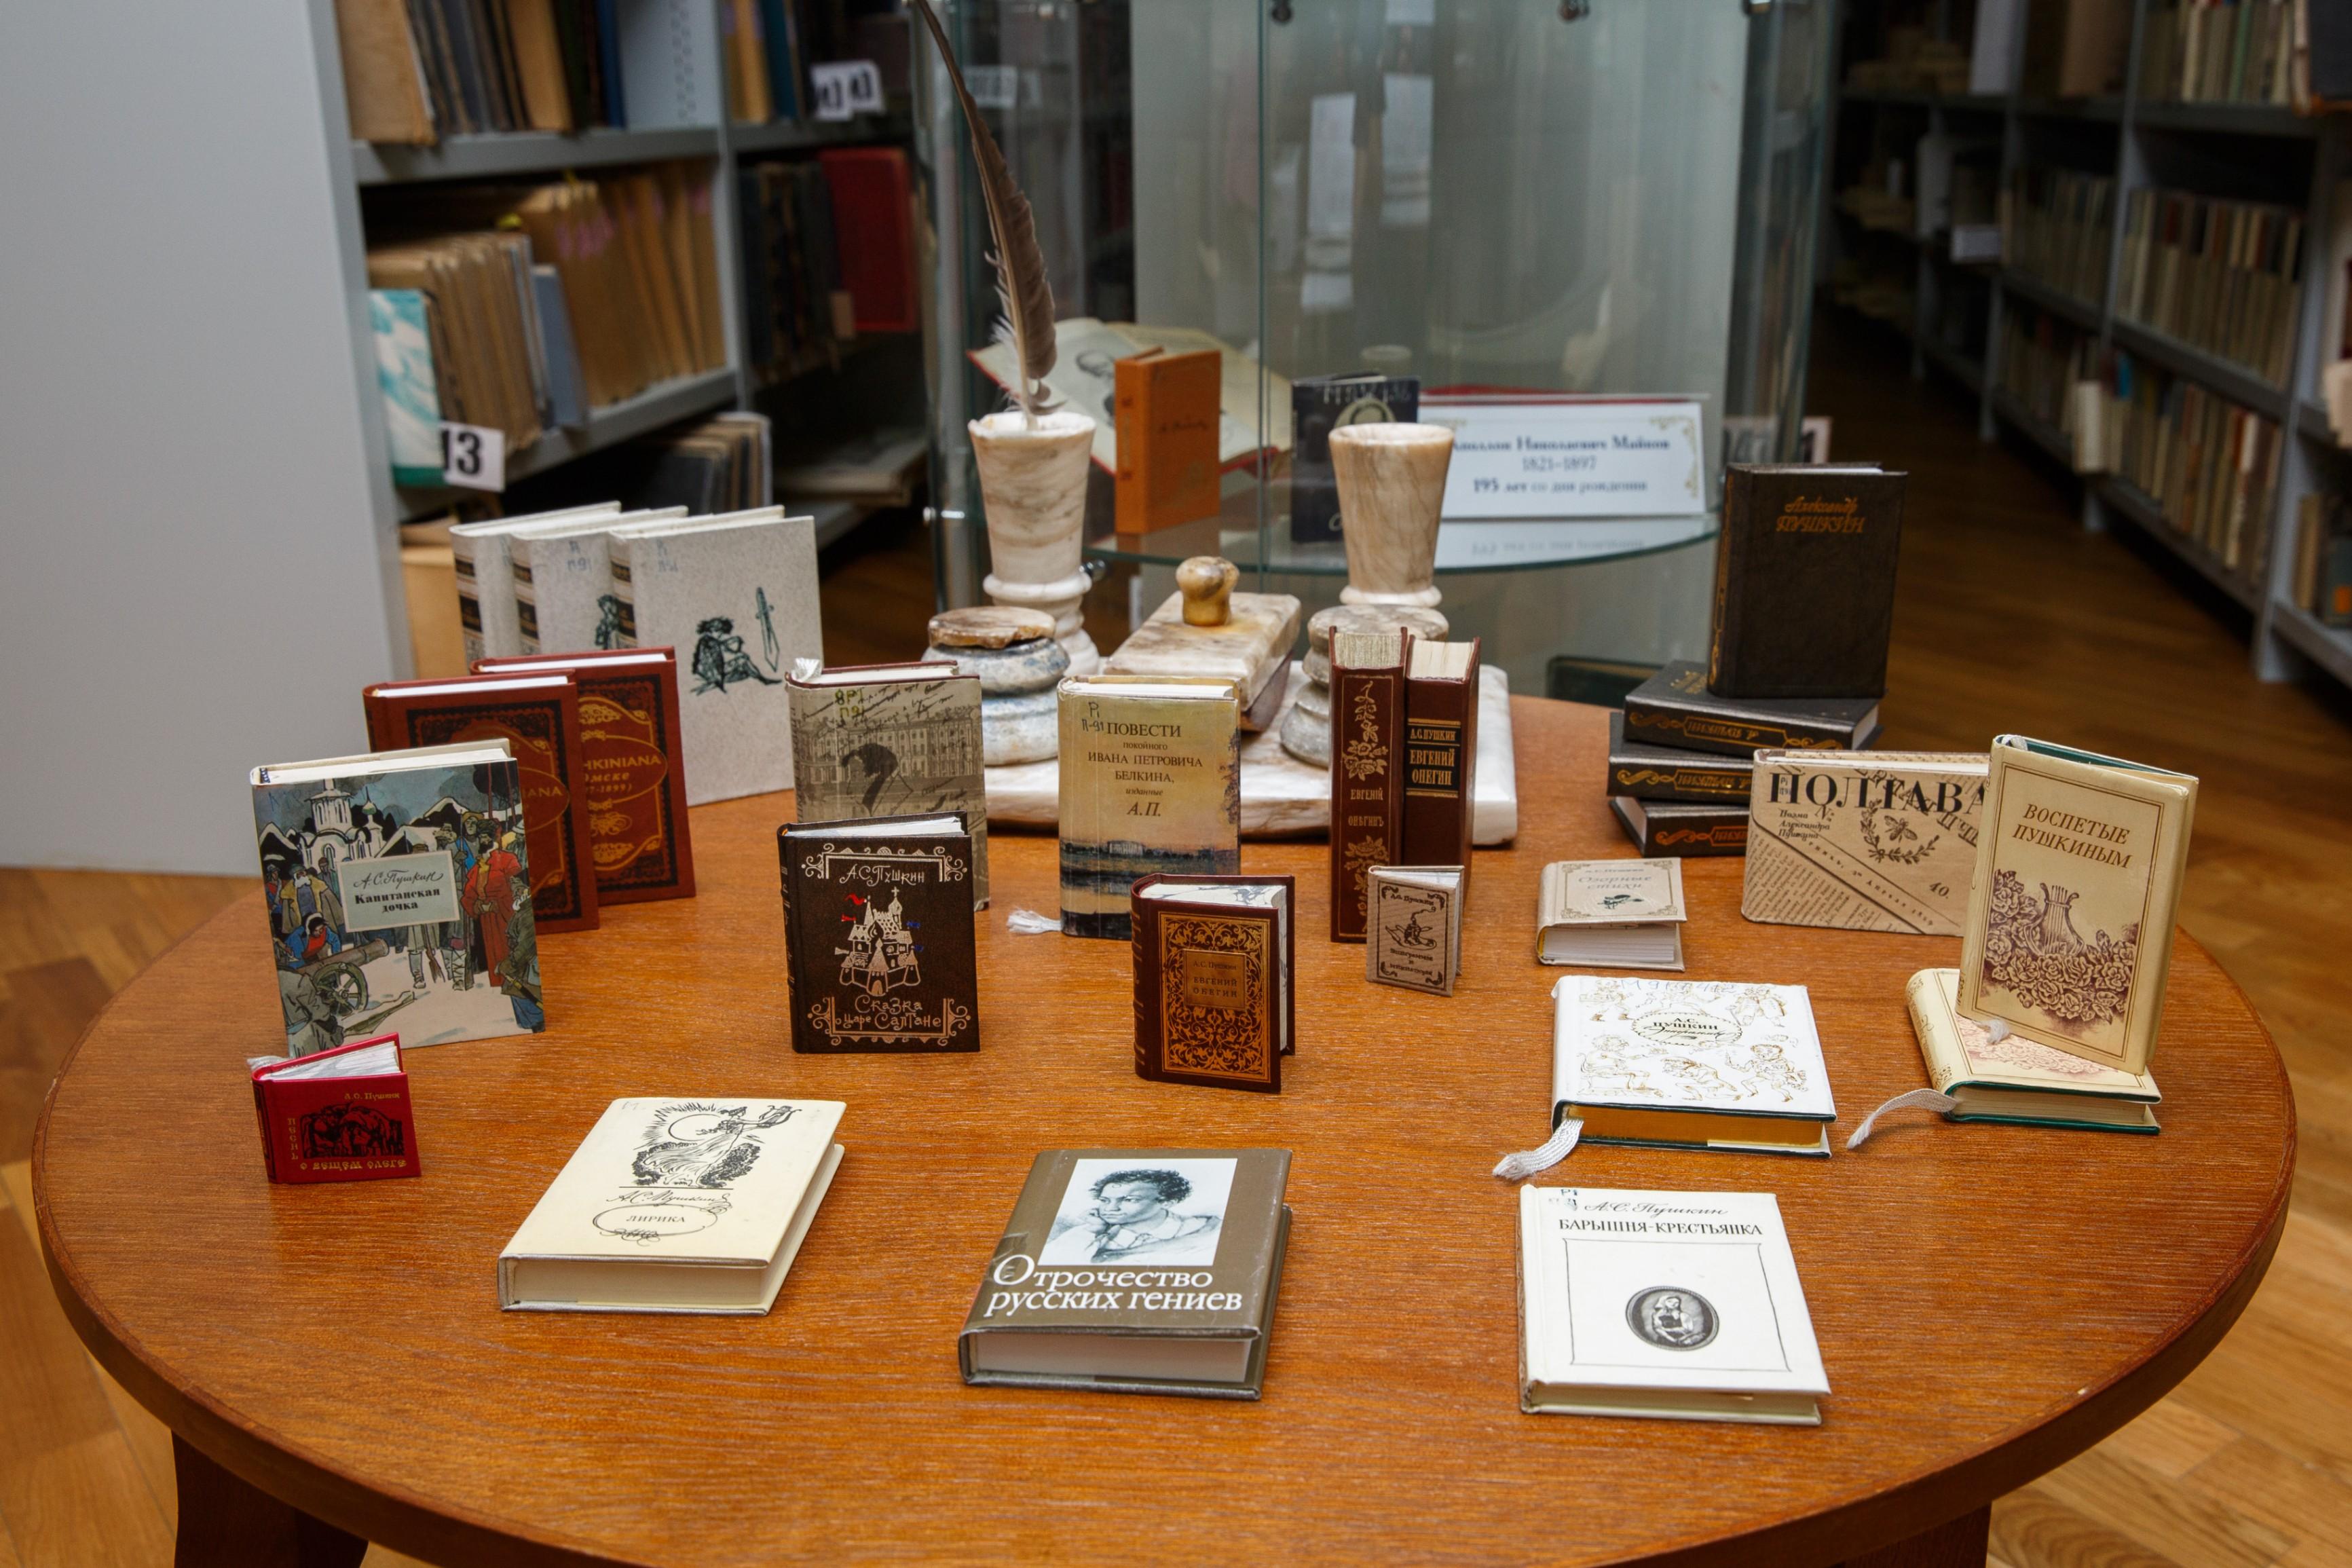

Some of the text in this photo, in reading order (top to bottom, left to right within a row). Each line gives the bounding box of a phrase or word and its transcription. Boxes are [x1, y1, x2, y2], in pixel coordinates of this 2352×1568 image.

[1106, 722, 1182, 738] ПОВЕСТИ
[1123, 741, 1168, 751] покойного
[1088, 751, 1203, 767] ИВАНА ПЕТРОВИЧА
[1409, 748, 1455, 767] ЕВГЕНИЙ
[1115, 770, 1175, 784] БЕЛКИНА,
[1411, 768, 1453, 785] ОНЕГИН
[1125, 787, 1163, 796] изданные
[2023, 804, 2131, 845] ВОСПЕТЫЕ
[2012, 823, 2133, 869] ПУШКИНЫМ
[354, 888, 441, 904] Капитанская
[381, 901, 419, 914] дочка
[1194, 977, 1237, 986] ЕВГЕНИЙ
[1193, 987, 1237, 998] ОНЕГИН
[855, 994, 923, 1015] Сказка
[874, 1011, 941, 1031] Салтане
[1653, 1022, 1718, 1030] ПУШКИН
[1558, 1218, 1763, 1235] БАРЫШНЯ-КРЕСТЬЯНКА
[993, 1254, 1214, 1292] Отрочество
[983, 1290, 1243, 1318] русских гениев
